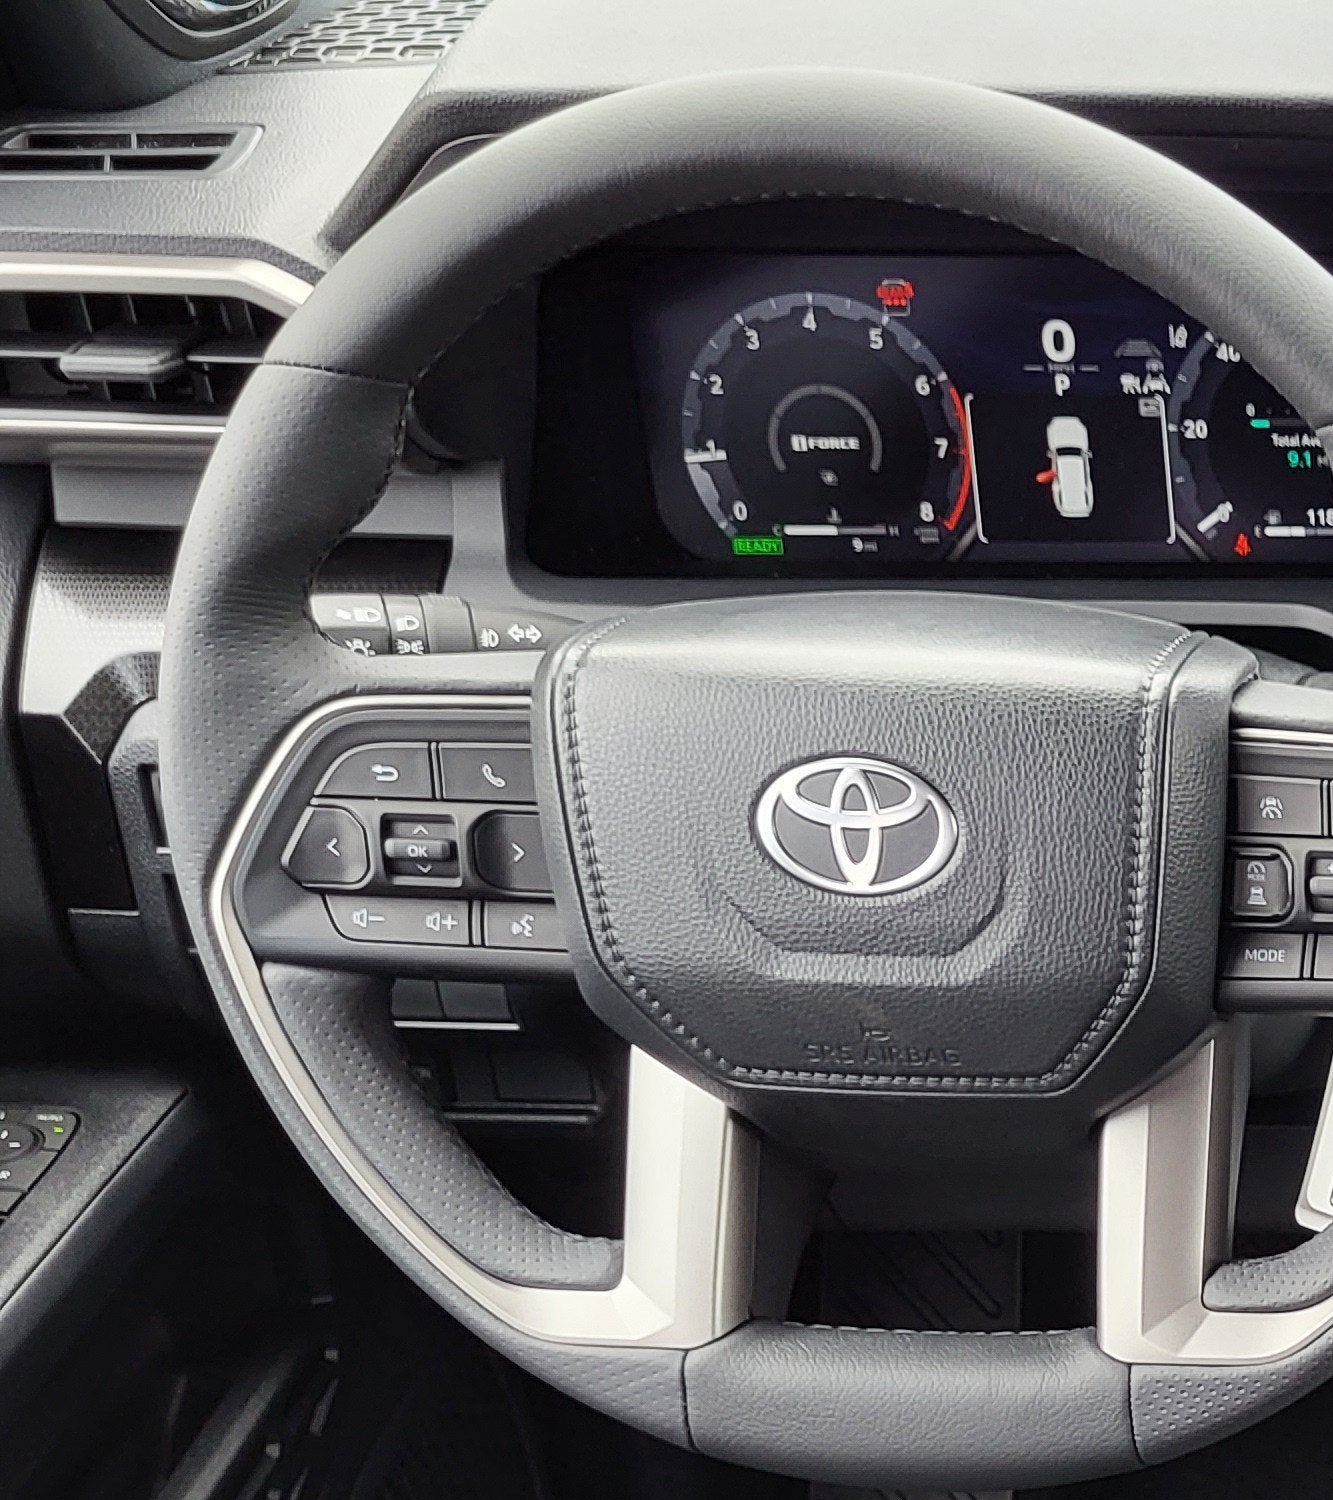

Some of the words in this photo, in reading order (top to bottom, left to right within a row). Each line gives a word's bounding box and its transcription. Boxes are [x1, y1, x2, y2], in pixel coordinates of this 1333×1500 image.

[802, 309, 817, 332] 4
[747, 329, 761, 350] 3
[869, 327, 883, 350] 5
[1041, 319, 1076, 363] 0
[708, 374, 725, 395] 2
[914, 375, 930, 396] 6
[1054, 373, 1071, 397] P
[1183, 418, 1208, 440] 20
[933, 437, 948, 459] 7
[1287, 450, 1312, 469] 9.1
[733, 500, 748, 521] 0
[919, 501, 935, 522] 8
[407, 845, 428, 858] OK
[1244, 949, 1286, 963] MODE
